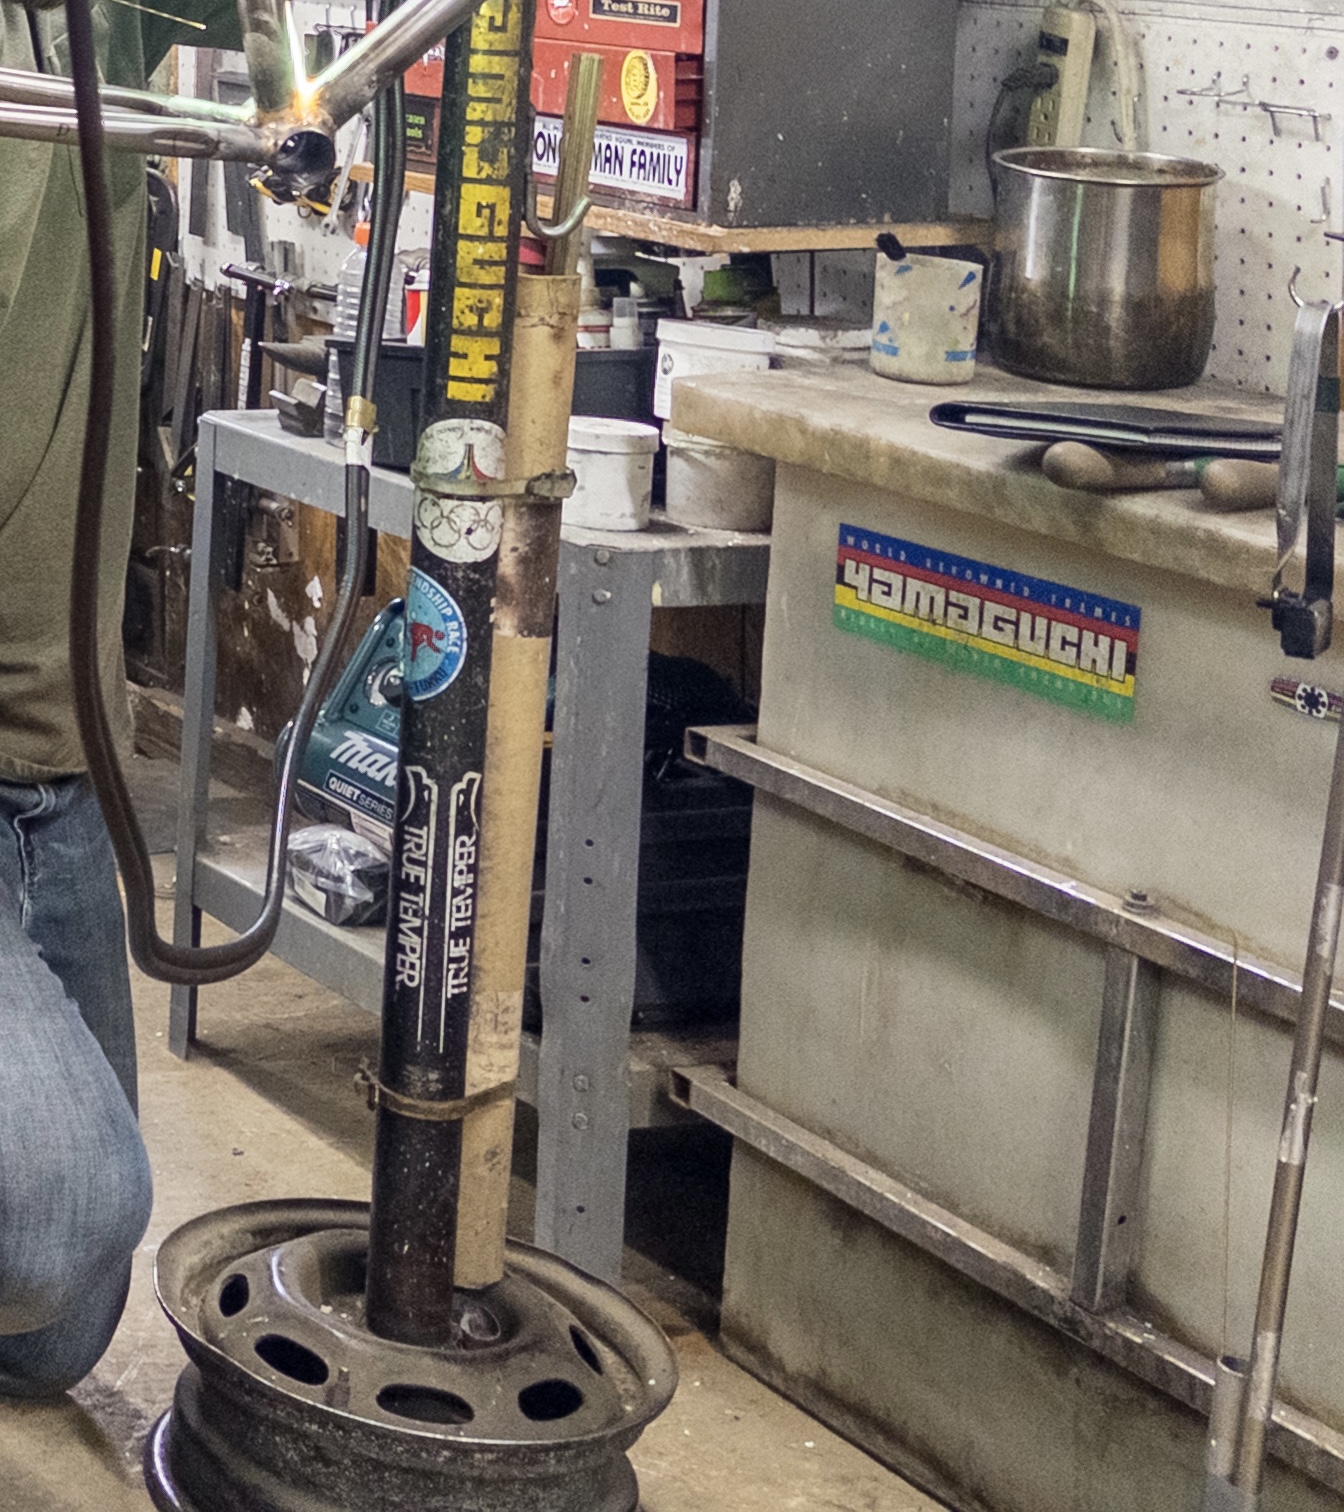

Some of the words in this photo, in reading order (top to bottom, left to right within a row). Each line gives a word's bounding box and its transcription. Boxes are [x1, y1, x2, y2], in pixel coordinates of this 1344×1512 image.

[637, 2, 671, 17] Rite
[535, 131, 561, 164] ON
[591, 142, 624, 177] MAN
[629, 147, 684, 187] FAMILY
[446, 620, 461, 654] RACE
[329, 776, 361, 802] QUIET
[359, 792, 394, 820] SERIES
[401, 825, 428, 882] TRUE
[450, 833, 477, 934] TEMPER
[396, 886, 424, 988] TEMPER
[446, 935, 470, 1000] TRUE
